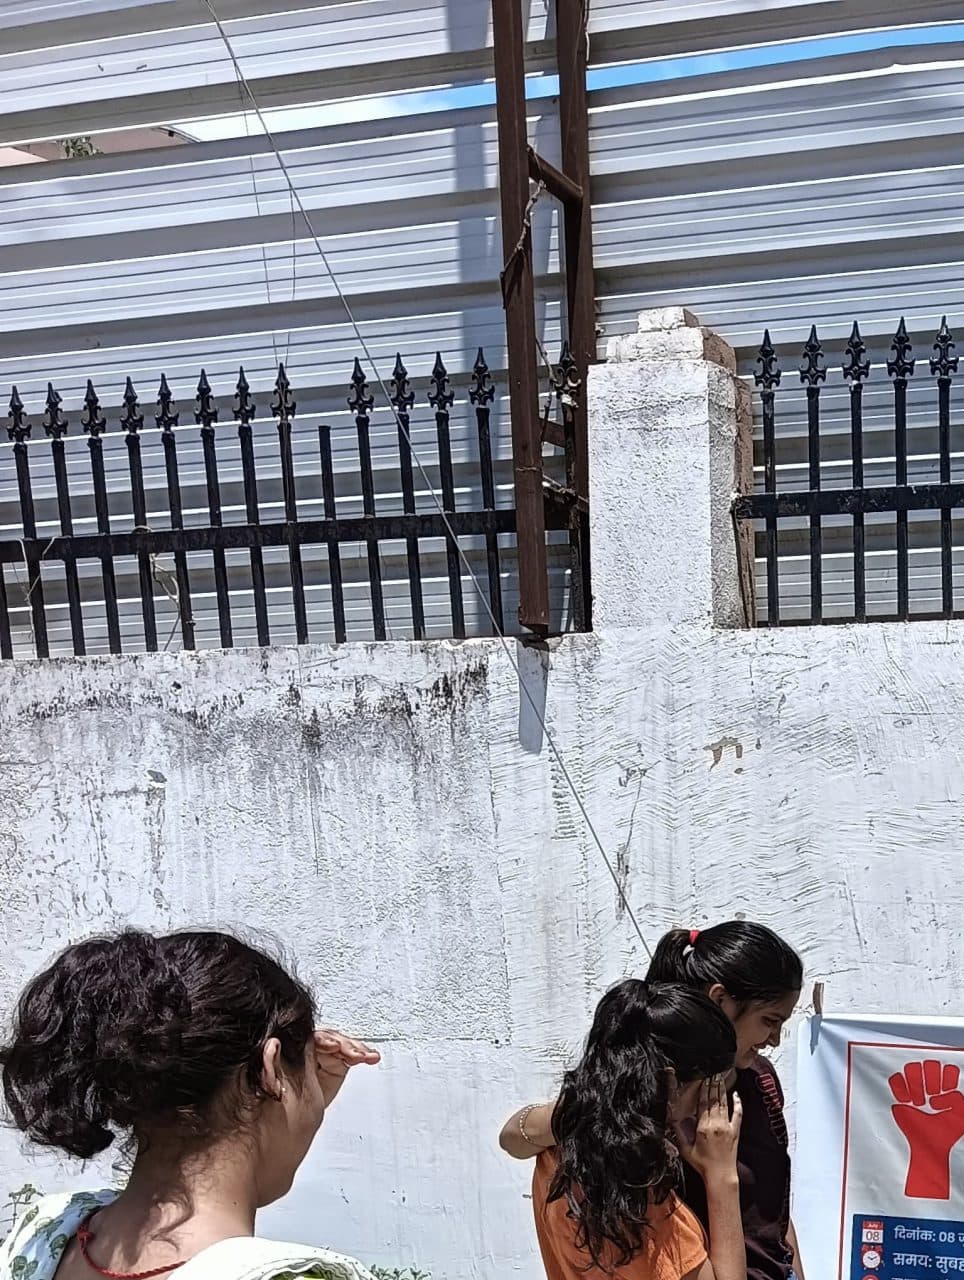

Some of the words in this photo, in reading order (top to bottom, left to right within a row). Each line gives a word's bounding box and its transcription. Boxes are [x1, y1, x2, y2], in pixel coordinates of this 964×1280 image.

[866, 1231, 880, 1241] 08
[894, 1225, 935, 1242] दिनांक:
[939, 1231, 955, 1243] 08
[893, 1253, 932, 1268] समय:
